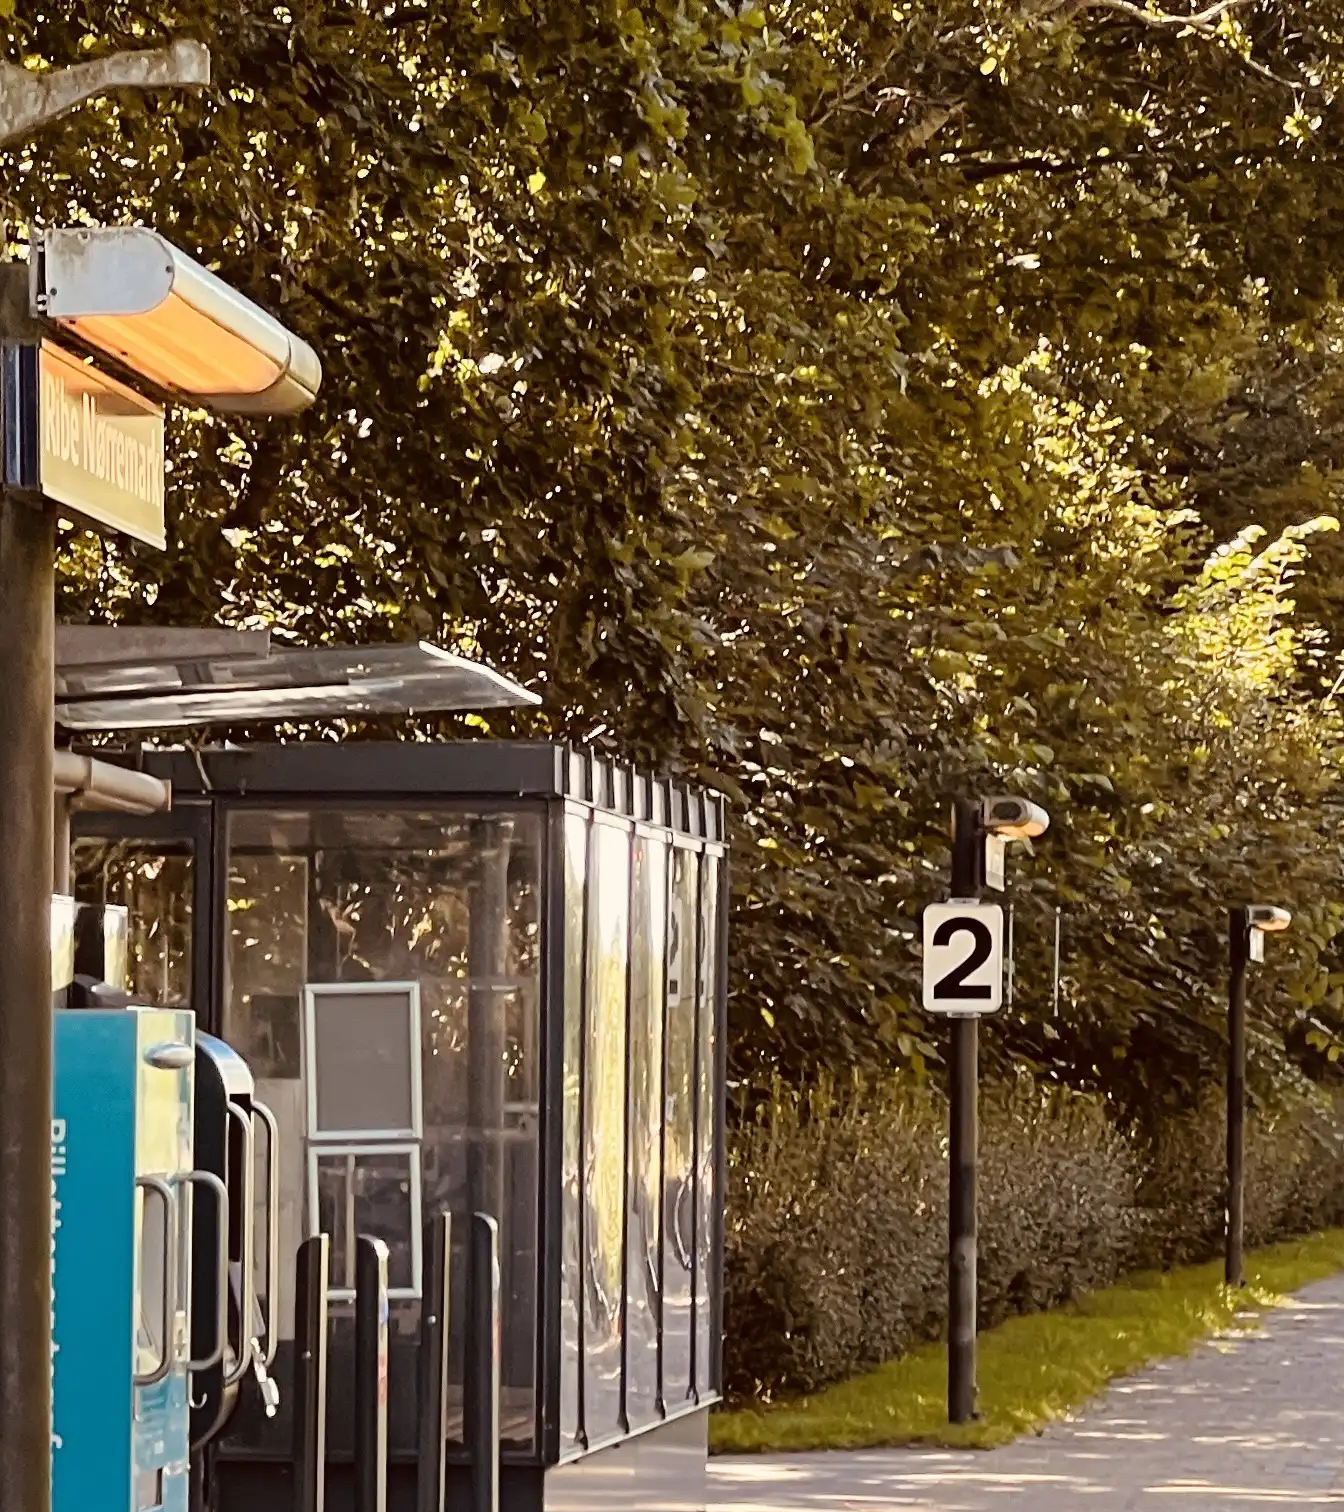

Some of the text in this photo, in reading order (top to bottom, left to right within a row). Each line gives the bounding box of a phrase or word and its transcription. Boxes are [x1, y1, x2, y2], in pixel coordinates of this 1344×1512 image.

[45, 374, 161, 508] Ribe Nørremark
[933, 917, 992, 999] 2
